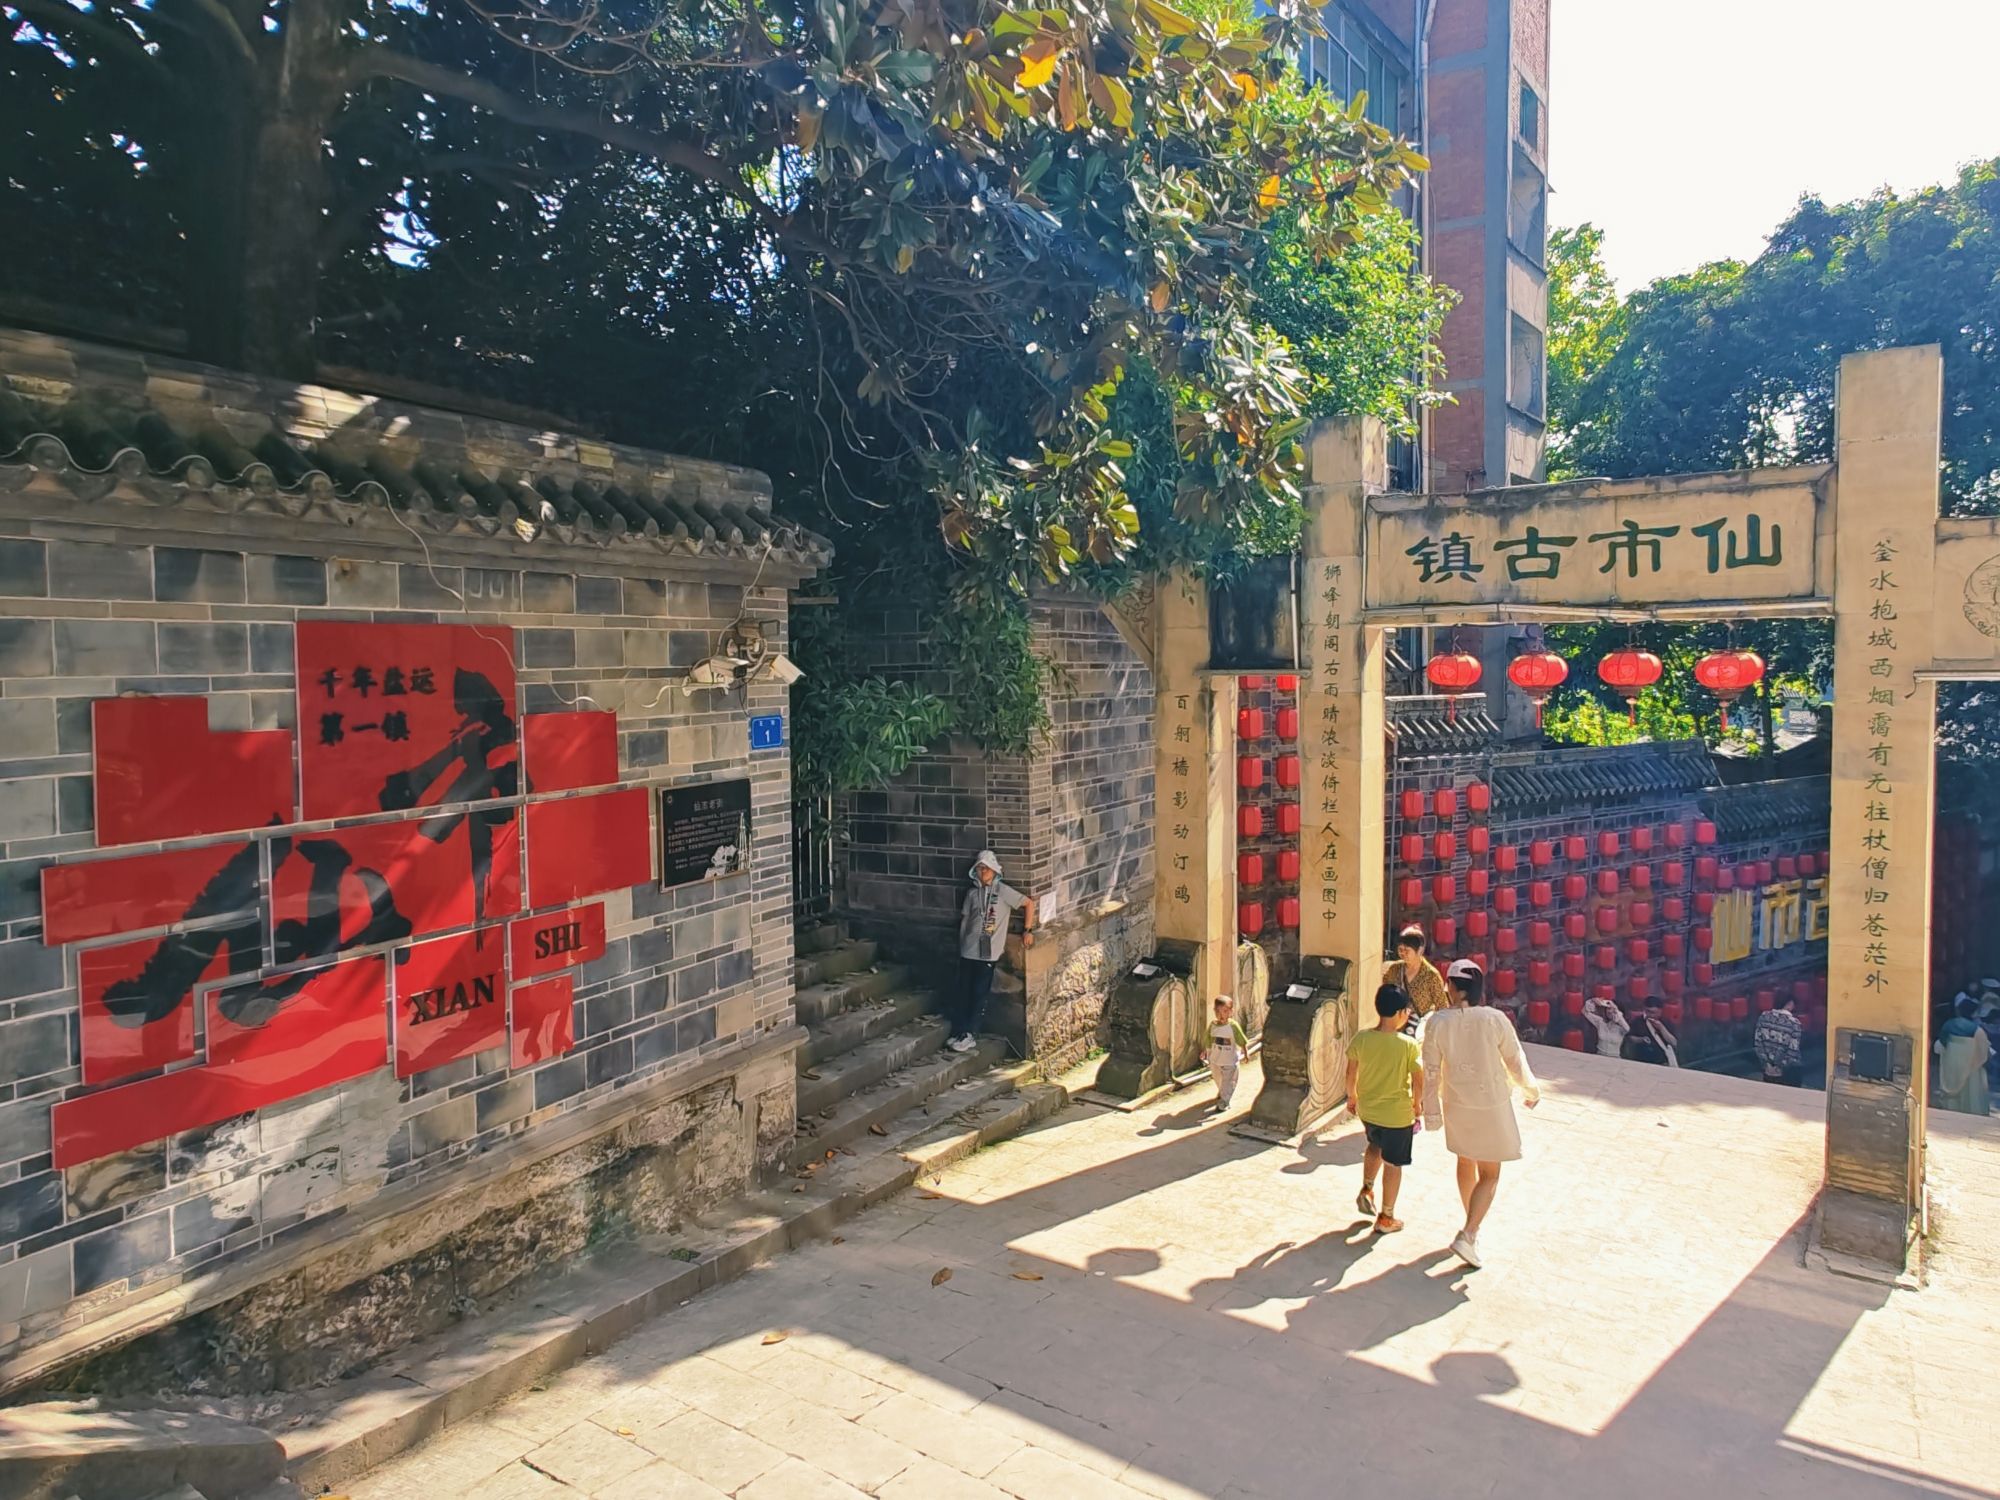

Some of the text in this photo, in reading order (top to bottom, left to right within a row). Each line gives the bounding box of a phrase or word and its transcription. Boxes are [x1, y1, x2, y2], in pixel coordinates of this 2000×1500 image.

[1405, 513, 1783, 584] 仙市古镇
[317, 665, 437, 698] 千年盐运
[764, 729, 770, 743] 1
[534, 922, 583, 960] SHI
[409, 974, 496, 1026] XIAN
